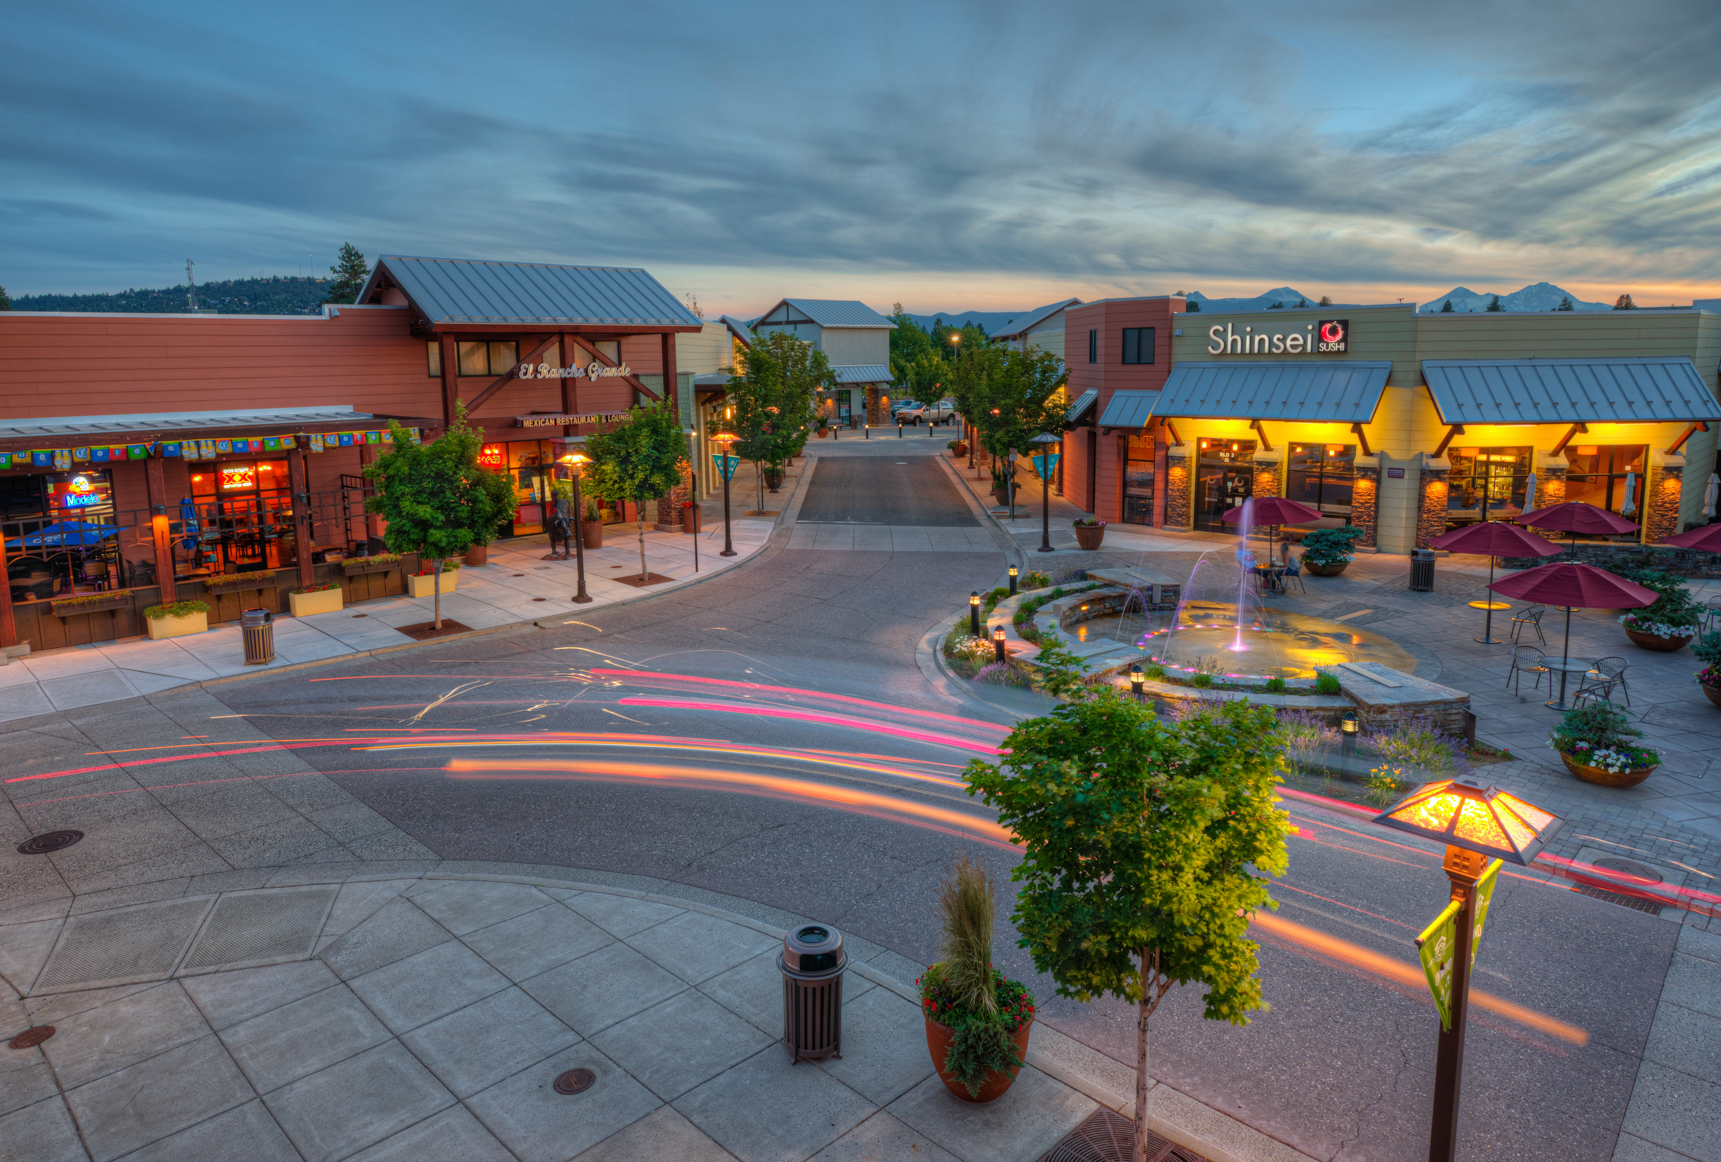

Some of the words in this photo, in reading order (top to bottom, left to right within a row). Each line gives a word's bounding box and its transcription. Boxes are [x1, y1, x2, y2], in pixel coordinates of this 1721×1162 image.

[1207, 322, 1313, 354] Shinsei
[1318, 342, 1345, 352] SUSHI
[518, 363, 534, 379] El
[536, 363, 585, 379] Rancho
[587, 362, 630, 382] Grande
[523, 418, 554, 428] MEXICAN
[557, 416, 600, 426] RESTAURANT
[607, 413, 633, 423] LOUNGE
[481, 455, 500, 464] OPEN
[66, 494, 100, 507] Modelo
